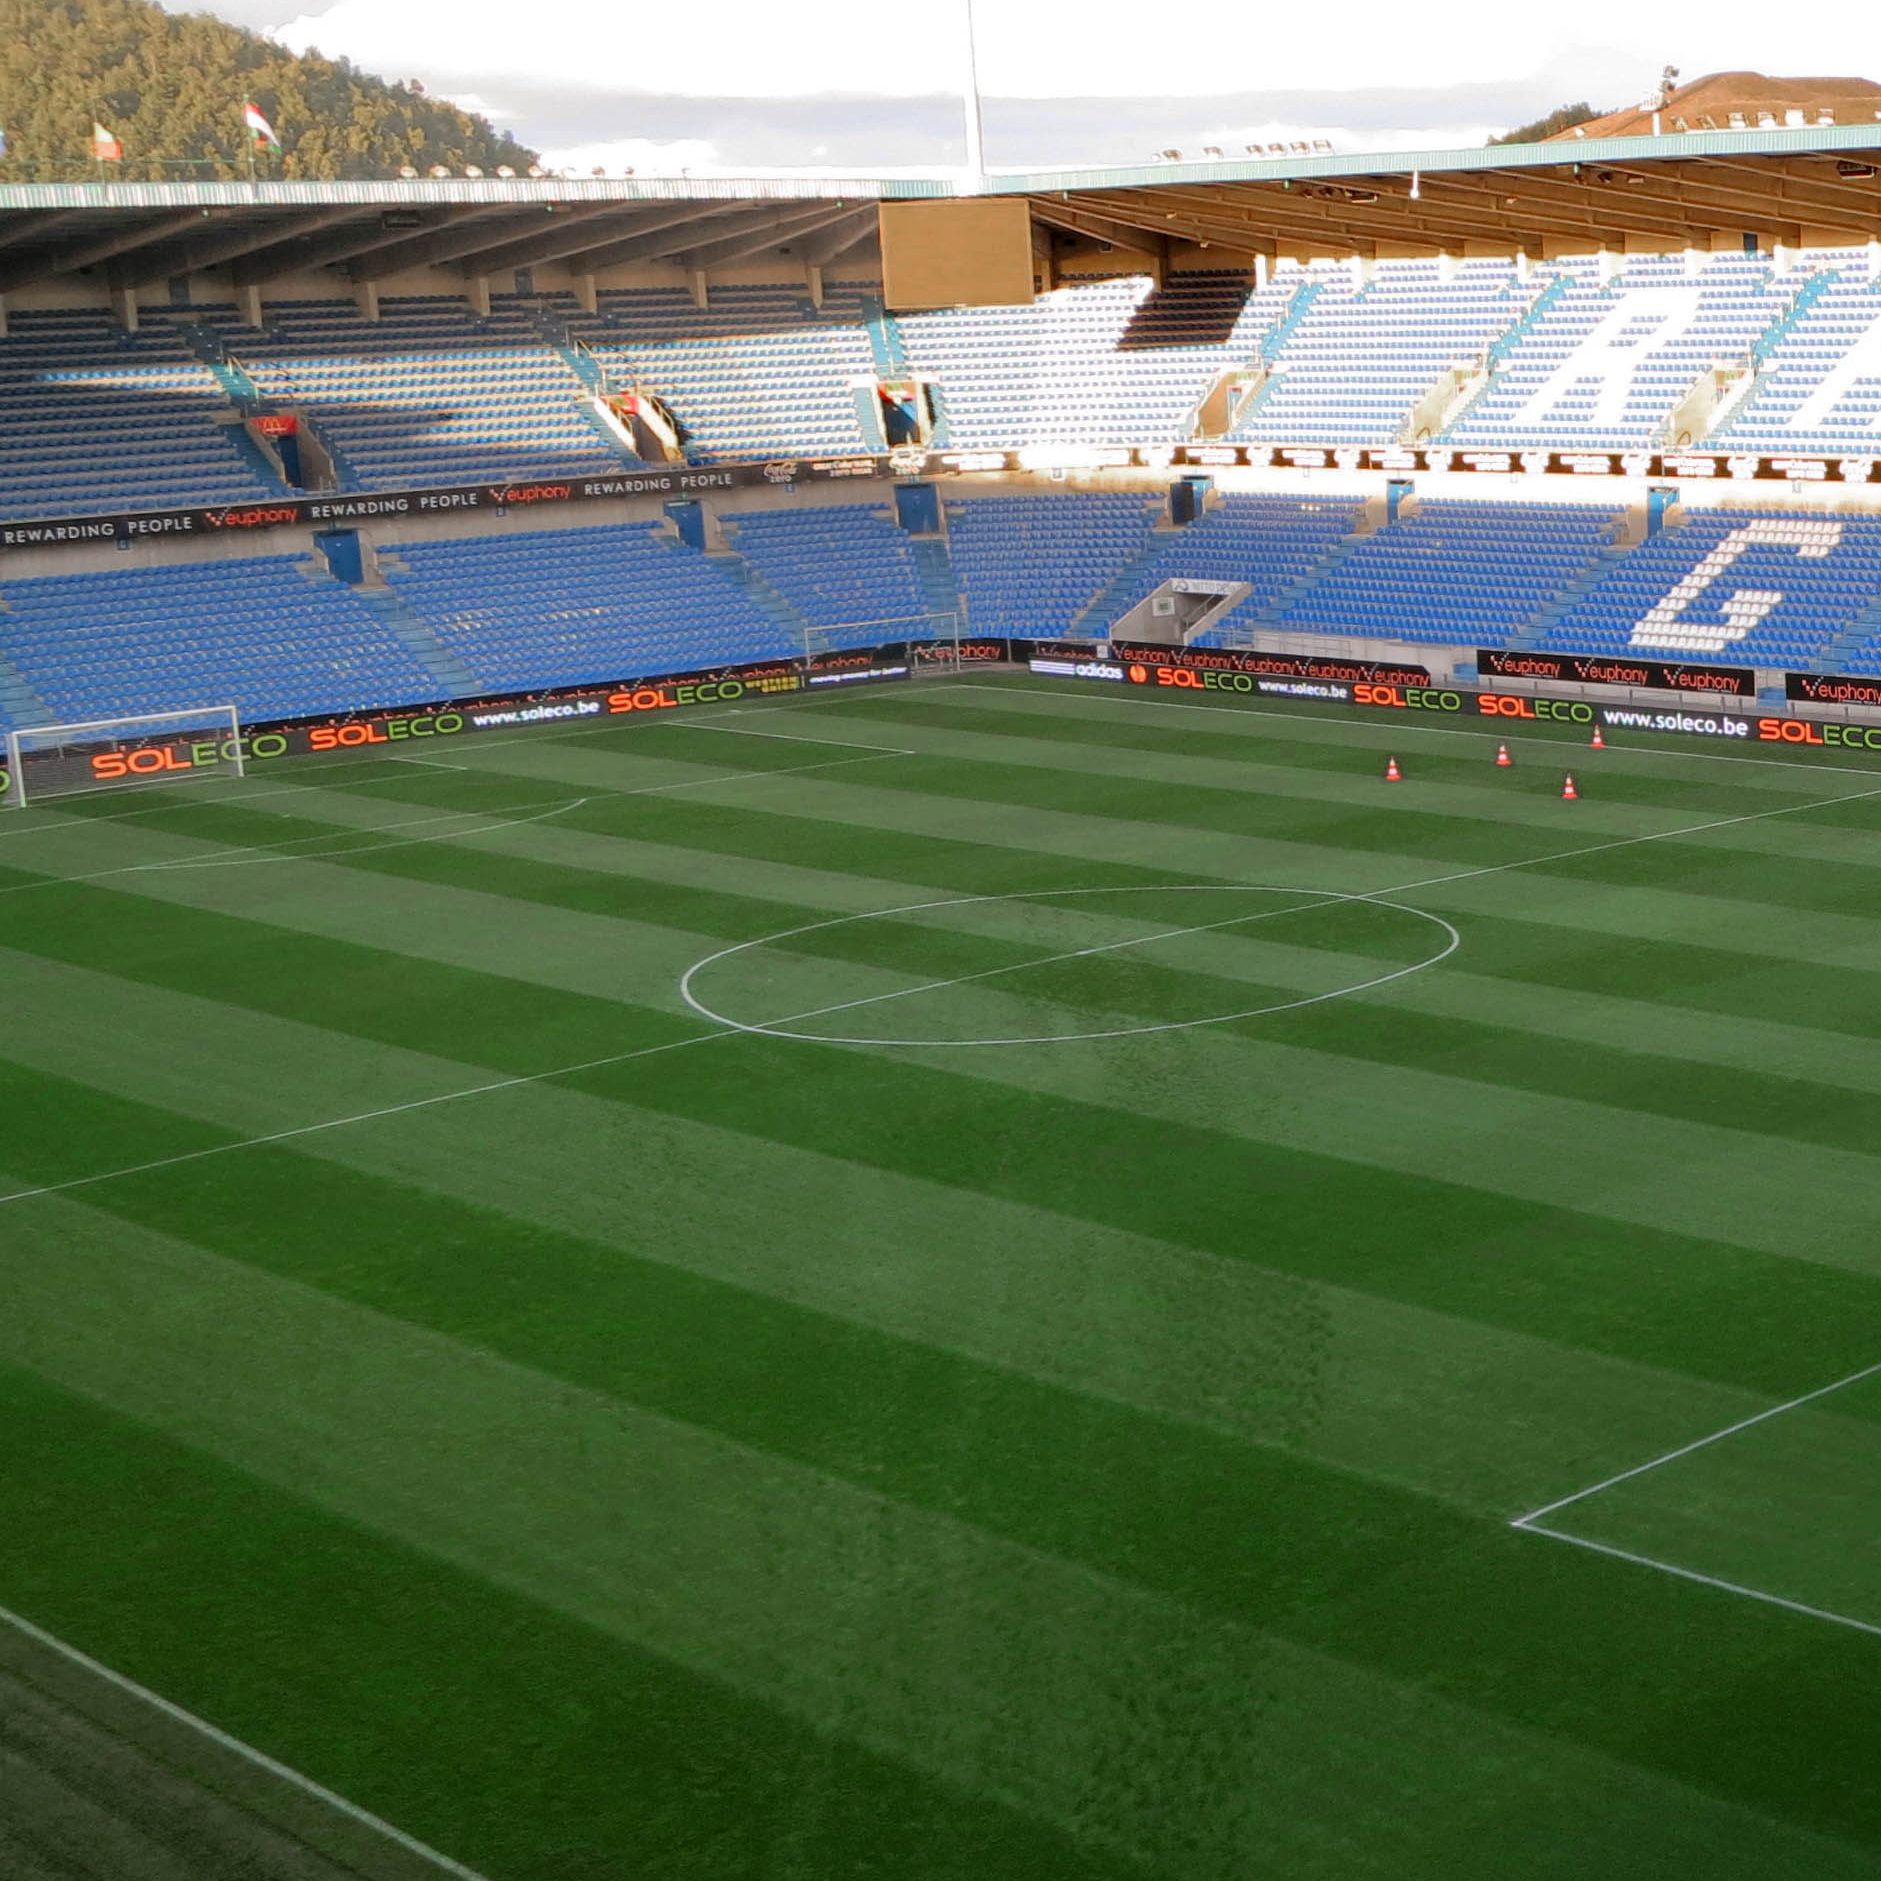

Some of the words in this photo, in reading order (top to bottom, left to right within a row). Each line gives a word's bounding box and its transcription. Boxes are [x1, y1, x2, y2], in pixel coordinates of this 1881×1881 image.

[5, 523, 115, 544] REWARDING
[128, 516, 193, 534] PEOPLE
[225, 507, 298, 526] euphony
[312, 499, 409, 518] REWARDING
[420, 493, 478, 509] PEOPLE
[507, 485, 571, 502] euphony
[584, 478, 671, 496] REWARDING
[681, 473, 733, 488] PEOPLE
[1076, 663, 1123, 679] adidas
[1125, 648, 1170, 664] euphony
[1184, 653, 1231, 669] euphony
[1246, 658, 1296, 675] euphony
[1309, 664, 1361, 681] euphony
[1374, 669, 1430, 686] euphony
[1504, 658, 1561, 677] euphony
[1589, 664, 1648, 684] euphony
[1679, 670, 1740, 693] euphony
[1156, 667, 1252, 692] SOLECO
[1258, 679, 1347, 699] www.soleco.be
[1353, 683, 1462, 712] SOLECO
[1478, 693, 1593, 723] SOLECO
[1603, 708, 1749, 736] www.soleco.be
[91, 734, 288, 779] SOLECO
[309, 713, 464, 750] SOLECO
[473, 701, 600, 727] www.soleco.be
[607, 680, 744, 714] SOLECO
